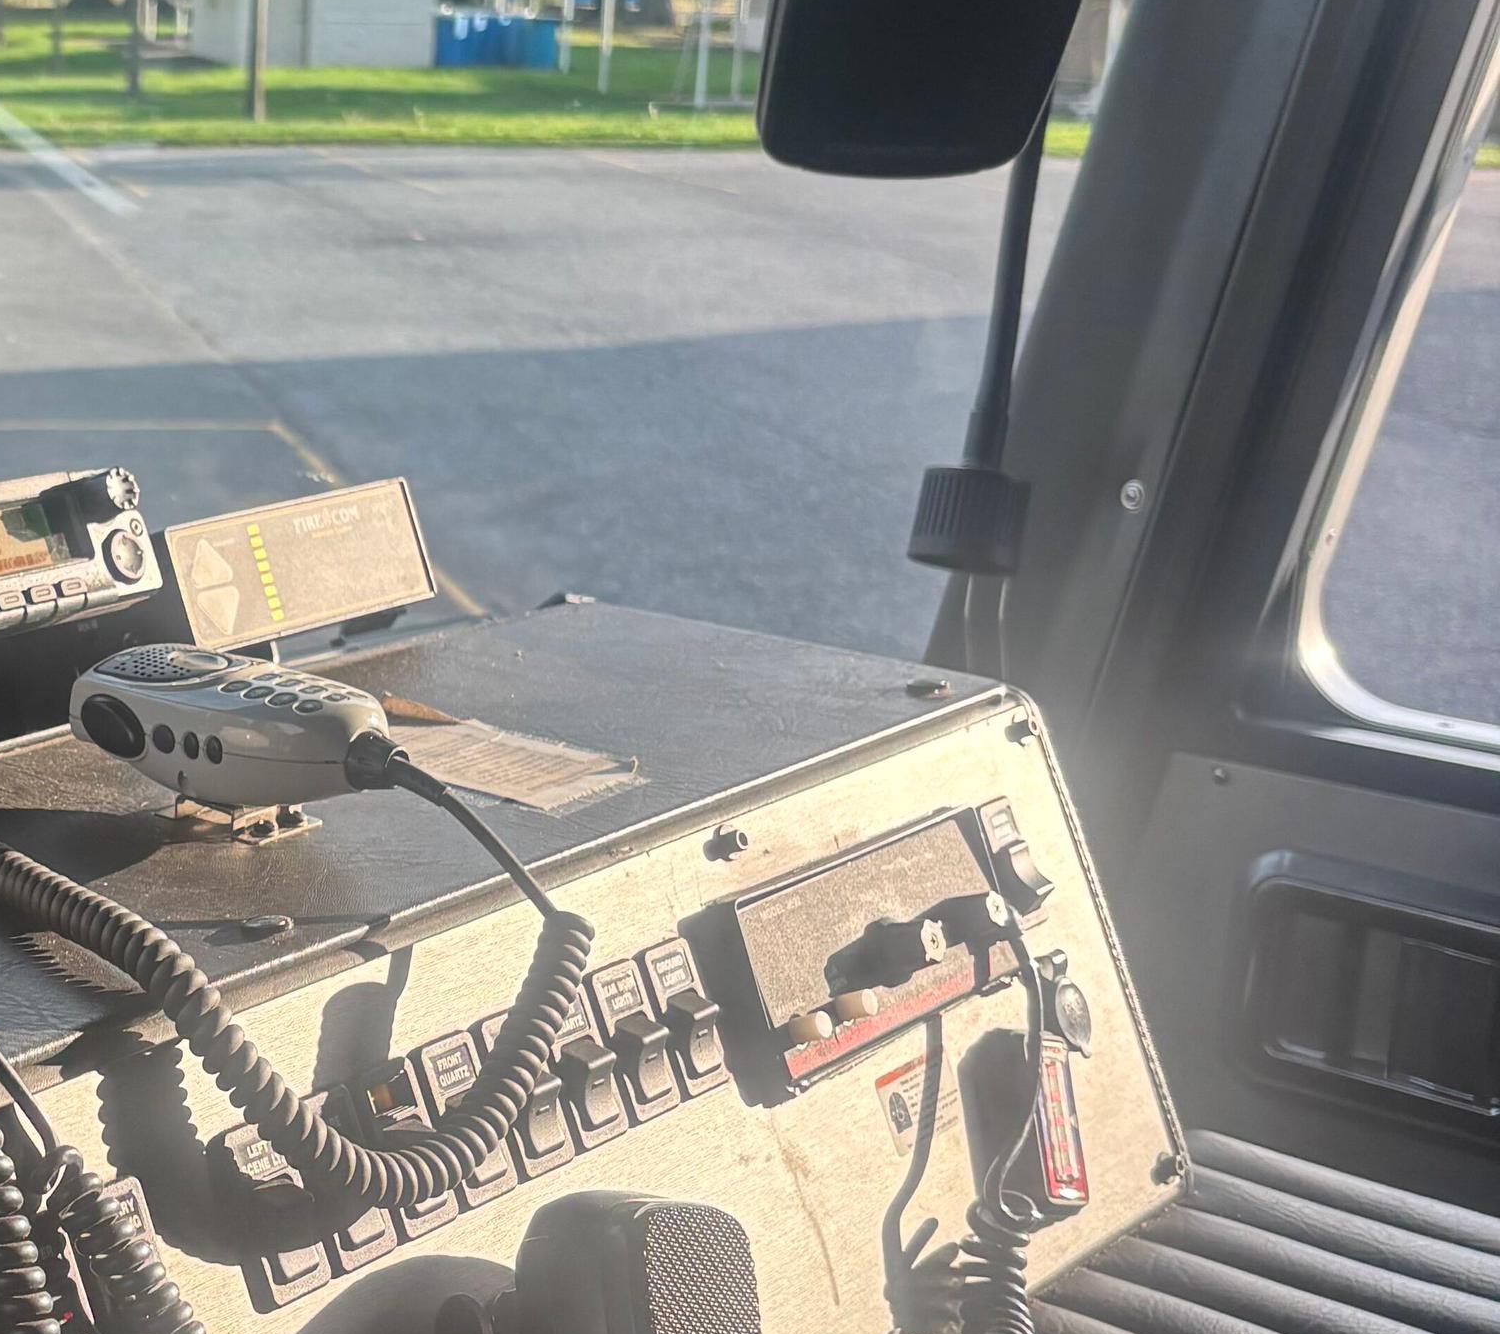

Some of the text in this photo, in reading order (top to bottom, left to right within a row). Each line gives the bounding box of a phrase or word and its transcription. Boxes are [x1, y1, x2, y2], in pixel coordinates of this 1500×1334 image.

[436, 1052, 462, 1071] FRONT
[440, 1065, 470, 1086] QUARTZ
[247, 1141, 268, 1158] LEFT
